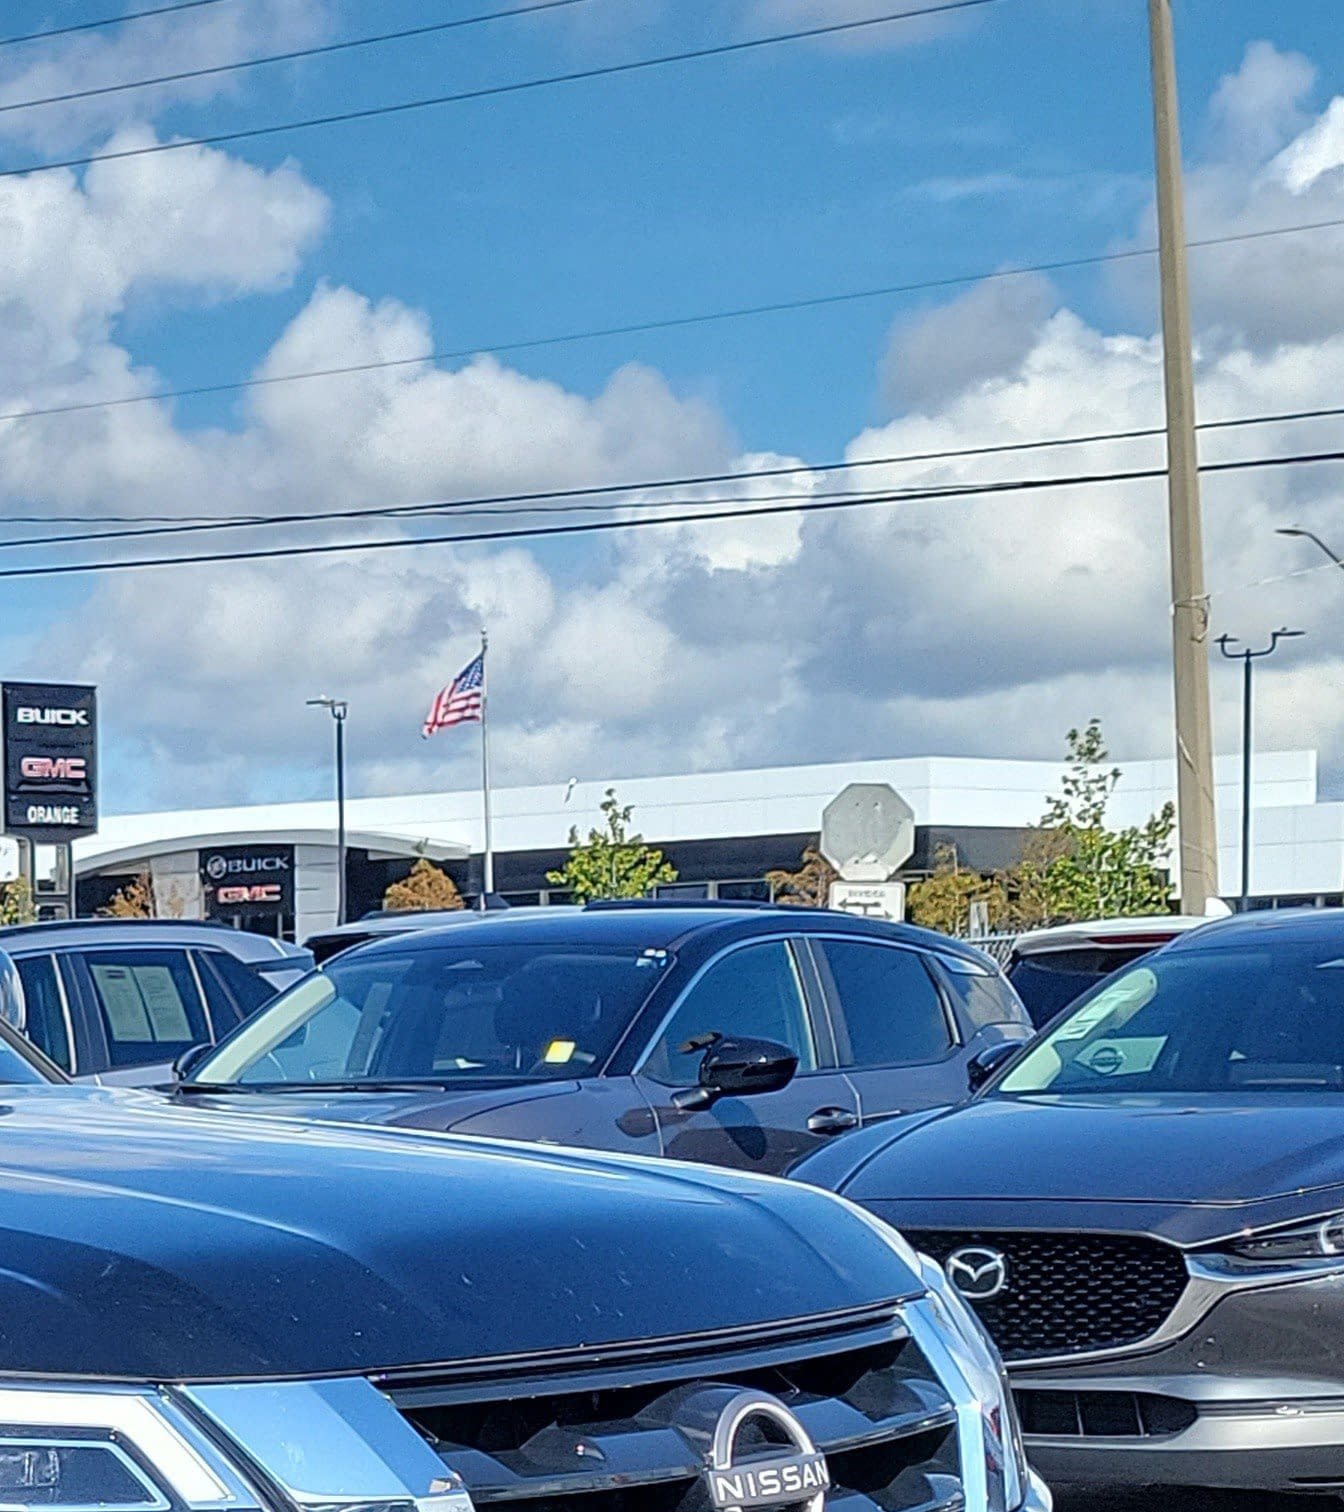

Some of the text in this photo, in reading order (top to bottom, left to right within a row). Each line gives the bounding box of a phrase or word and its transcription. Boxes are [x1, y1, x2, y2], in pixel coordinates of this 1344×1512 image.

[16, 706, 89, 726] BUICK
[21, 757, 86, 779] GMC
[27, 805, 79, 824] ORANGE
[228, 857, 289, 873] BUICK
[217, 884, 281, 904] GMC
[715, 1459, 830, 1502] NISSAN
